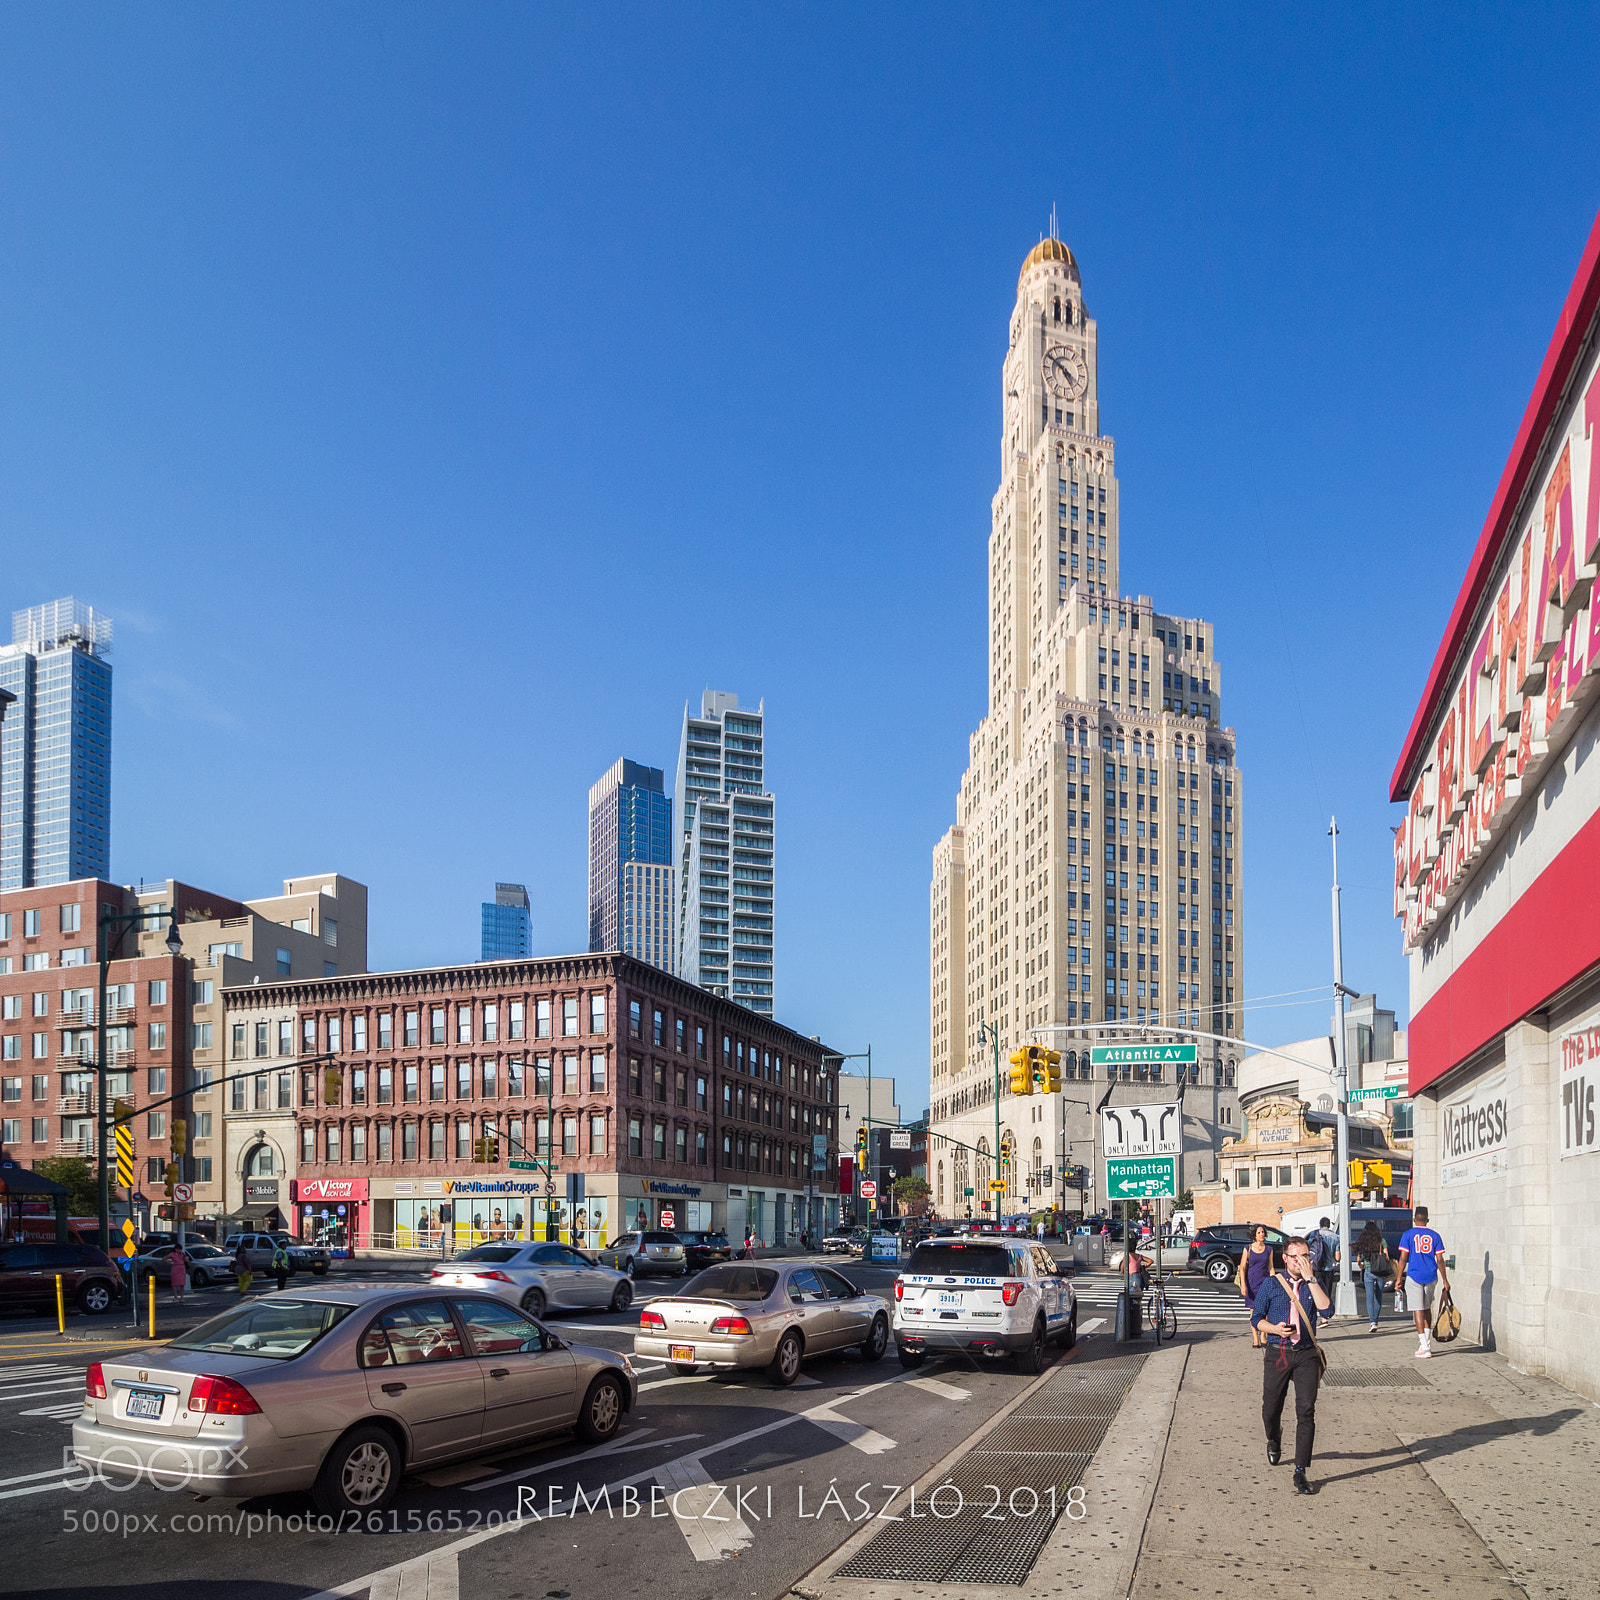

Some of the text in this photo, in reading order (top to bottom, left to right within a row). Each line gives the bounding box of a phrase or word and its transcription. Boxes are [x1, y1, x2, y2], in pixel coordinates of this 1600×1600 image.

[1105, 1048, 1181, 1061] Atlantic Av
[1561, 1034, 1585, 1072] The
[1351, 1088, 1388, 1102] Atlantic
[1562, 1075, 1595, 1150] TVs
[1258, 1127, 1292, 1137] ATLANTIC
[1262, 1135, 1290, 1143] AVENUE
[1108, 1145, 1125, 1154] ONLY
[1133, 1144, 1150, 1153] ONLY
[1158, 1142, 1176, 1151] ONLY
[1110, 1163, 1171, 1176] Manhattan
[317, 1180, 353, 1197] Victory
[1413, 1233, 1433, 1254] 18
[911, 1275, 934, 1283] NYPD
[963, 1277, 997, 1285] POLICE
